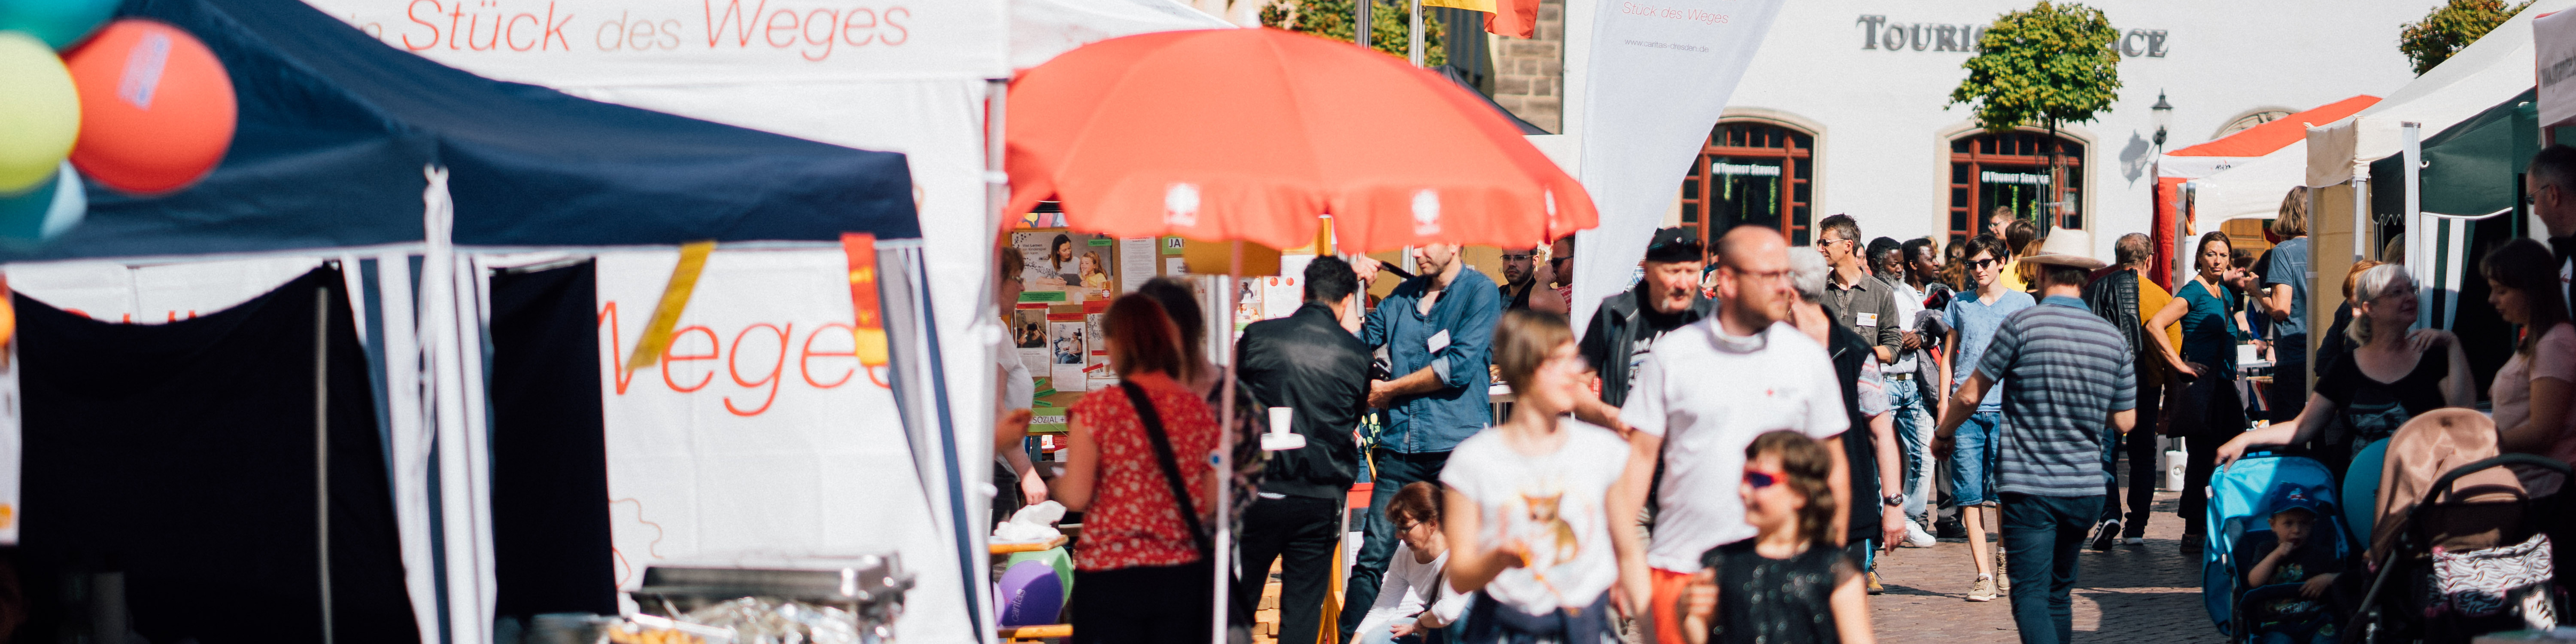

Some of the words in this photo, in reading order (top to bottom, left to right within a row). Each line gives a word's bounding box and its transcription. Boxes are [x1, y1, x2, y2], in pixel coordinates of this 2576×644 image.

[1622, 1, 1658, 17] Stück
[1661, 6, 1683, 20] des
[1688, 8, 1729, 25] Weges
[402, 0, 574, 51] Stück
[596, 9, 682, 52] des
[704, 0, 911, 62] Weges
[1625, 39, 1710, 53] www.caritas-dresden.de
[598, 300, 891, 417] ege
[1012, 589, 1026, 622] caritas
